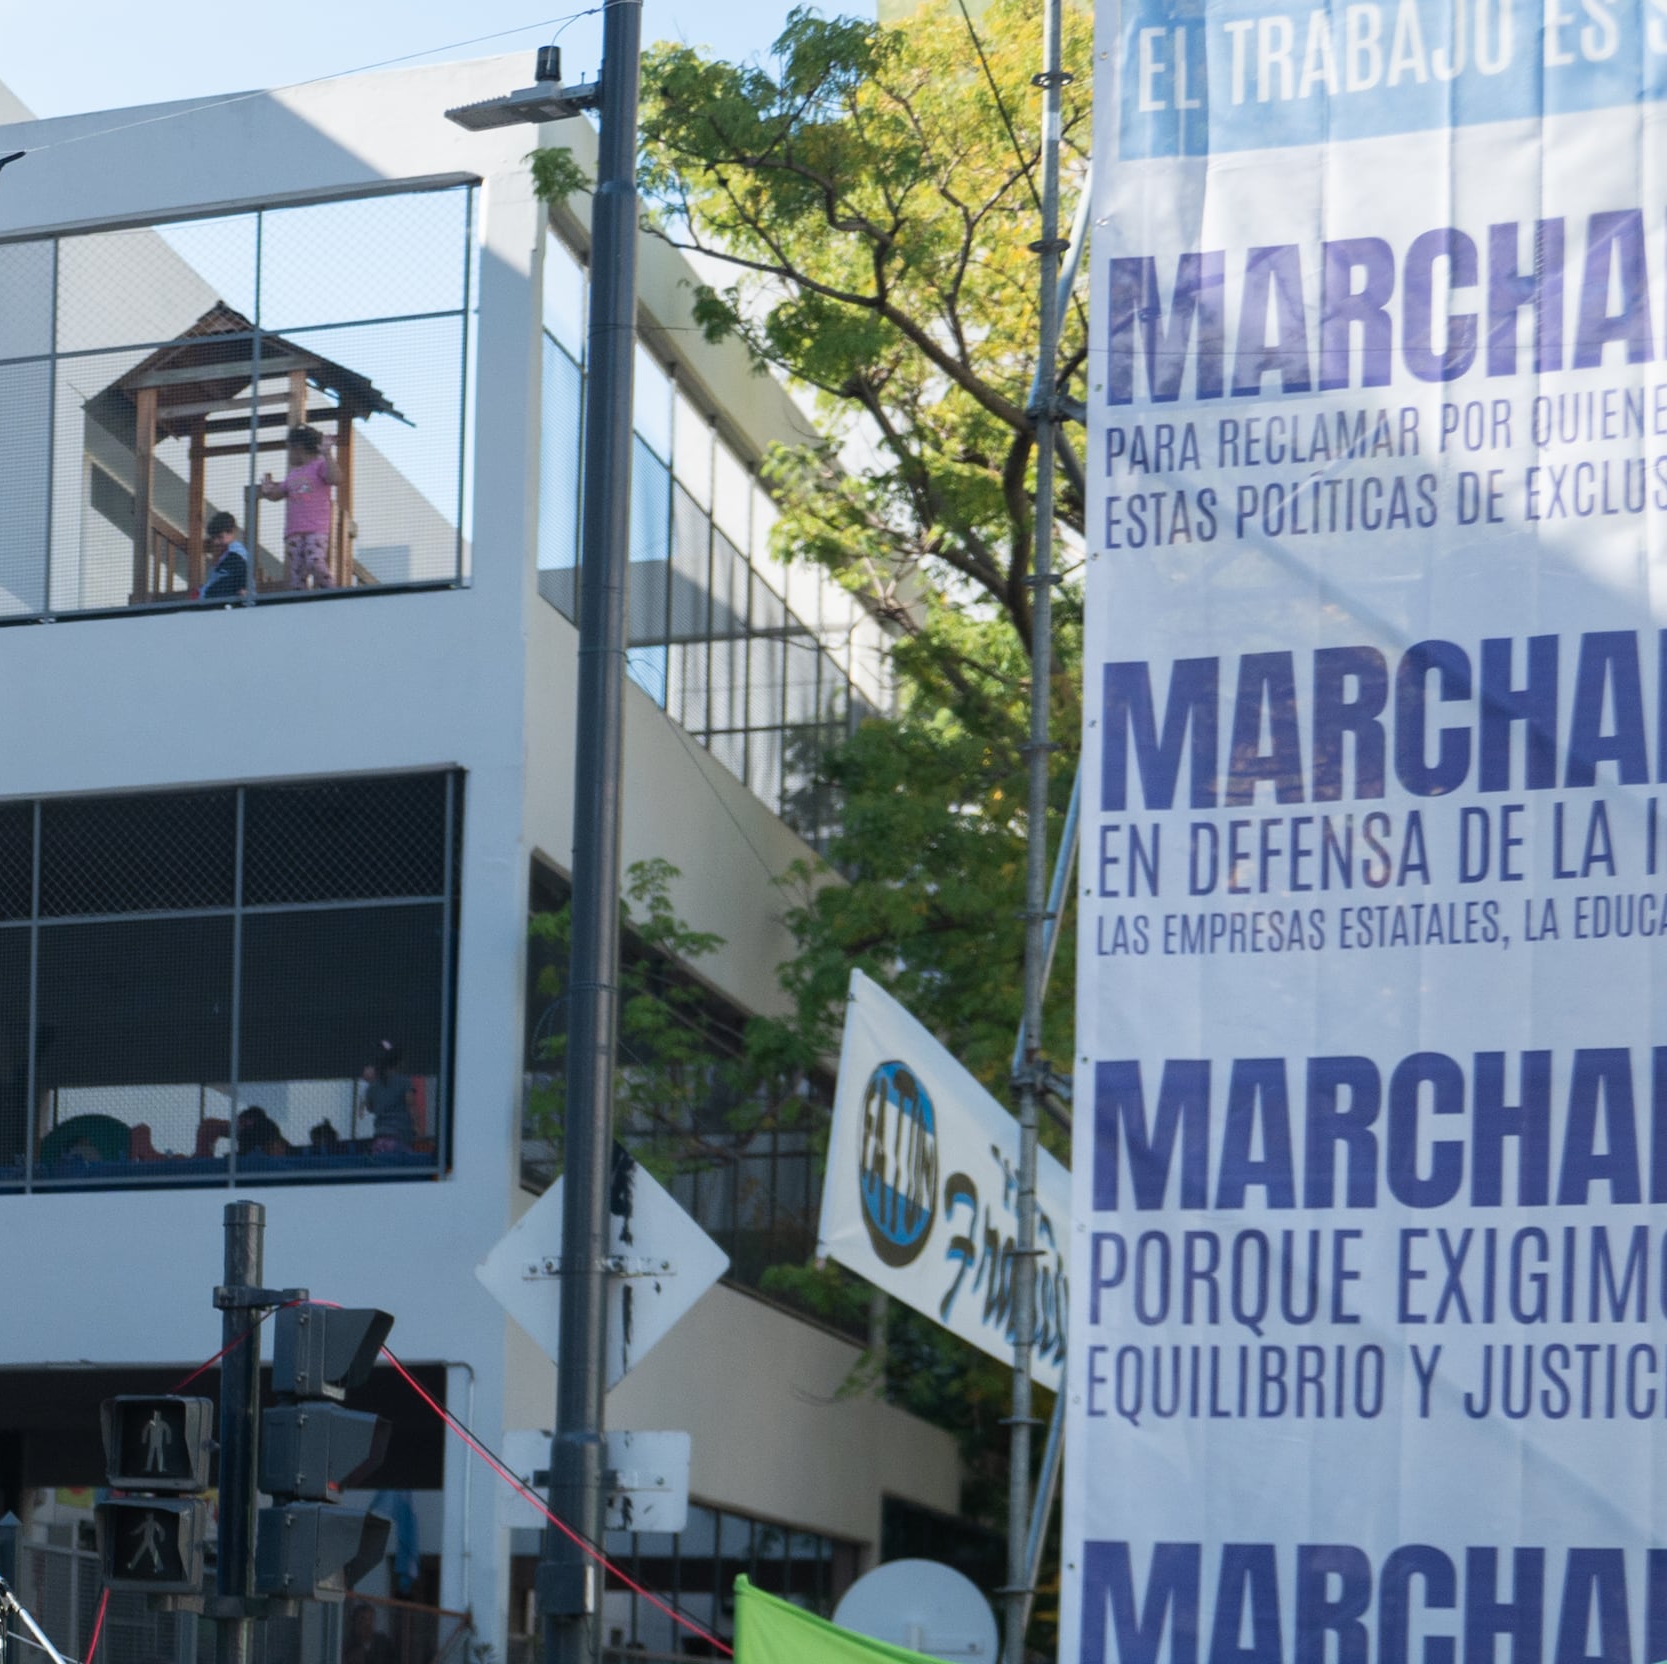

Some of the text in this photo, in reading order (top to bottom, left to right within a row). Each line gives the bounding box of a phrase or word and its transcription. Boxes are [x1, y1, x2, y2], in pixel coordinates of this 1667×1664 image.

[1138, 25, 1201, 114] EL
[1223, 0, 1515, 107] TRABAJO
[1106, 203, 1667, 407] MARCHA
[1105, 421, 1200, 477] PARA
[1218, 406, 1421, 468] RECLAMAR
[1441, 399, 1512, 453] POR
[1105, 489, 1217, 549] ESTAS
[1237, 471, 1438, 539] POLÍTICAS
[1457, 470, 1504, 526] DE
[1099, 628, 1667, 813] MARCHA
[1099, 823, 1160, 898] EN
[1189, 810, 1430, 897] DEFENSA
[1459, 804, 1525, 885] DE
[1553, 799, 1616, 880] LA
[1096, 912, 1150, 957] LAS
[1162, 907, 1326, 955] EMPRESAS
[1339, 900, 1511, 951] ESTATALES,
[1524, 897, 1560, 942] LA
[1092, 1045, 1667, 1212] MARCHA
[1088, 1227, 1363, 1338] PORQUE
[1398, 1224, 1667, 1326] EXIGIM
[1086, 1343, 1385, 1427] EQUILIBRIO
[1409, 1344, 1443, 1419] Y
